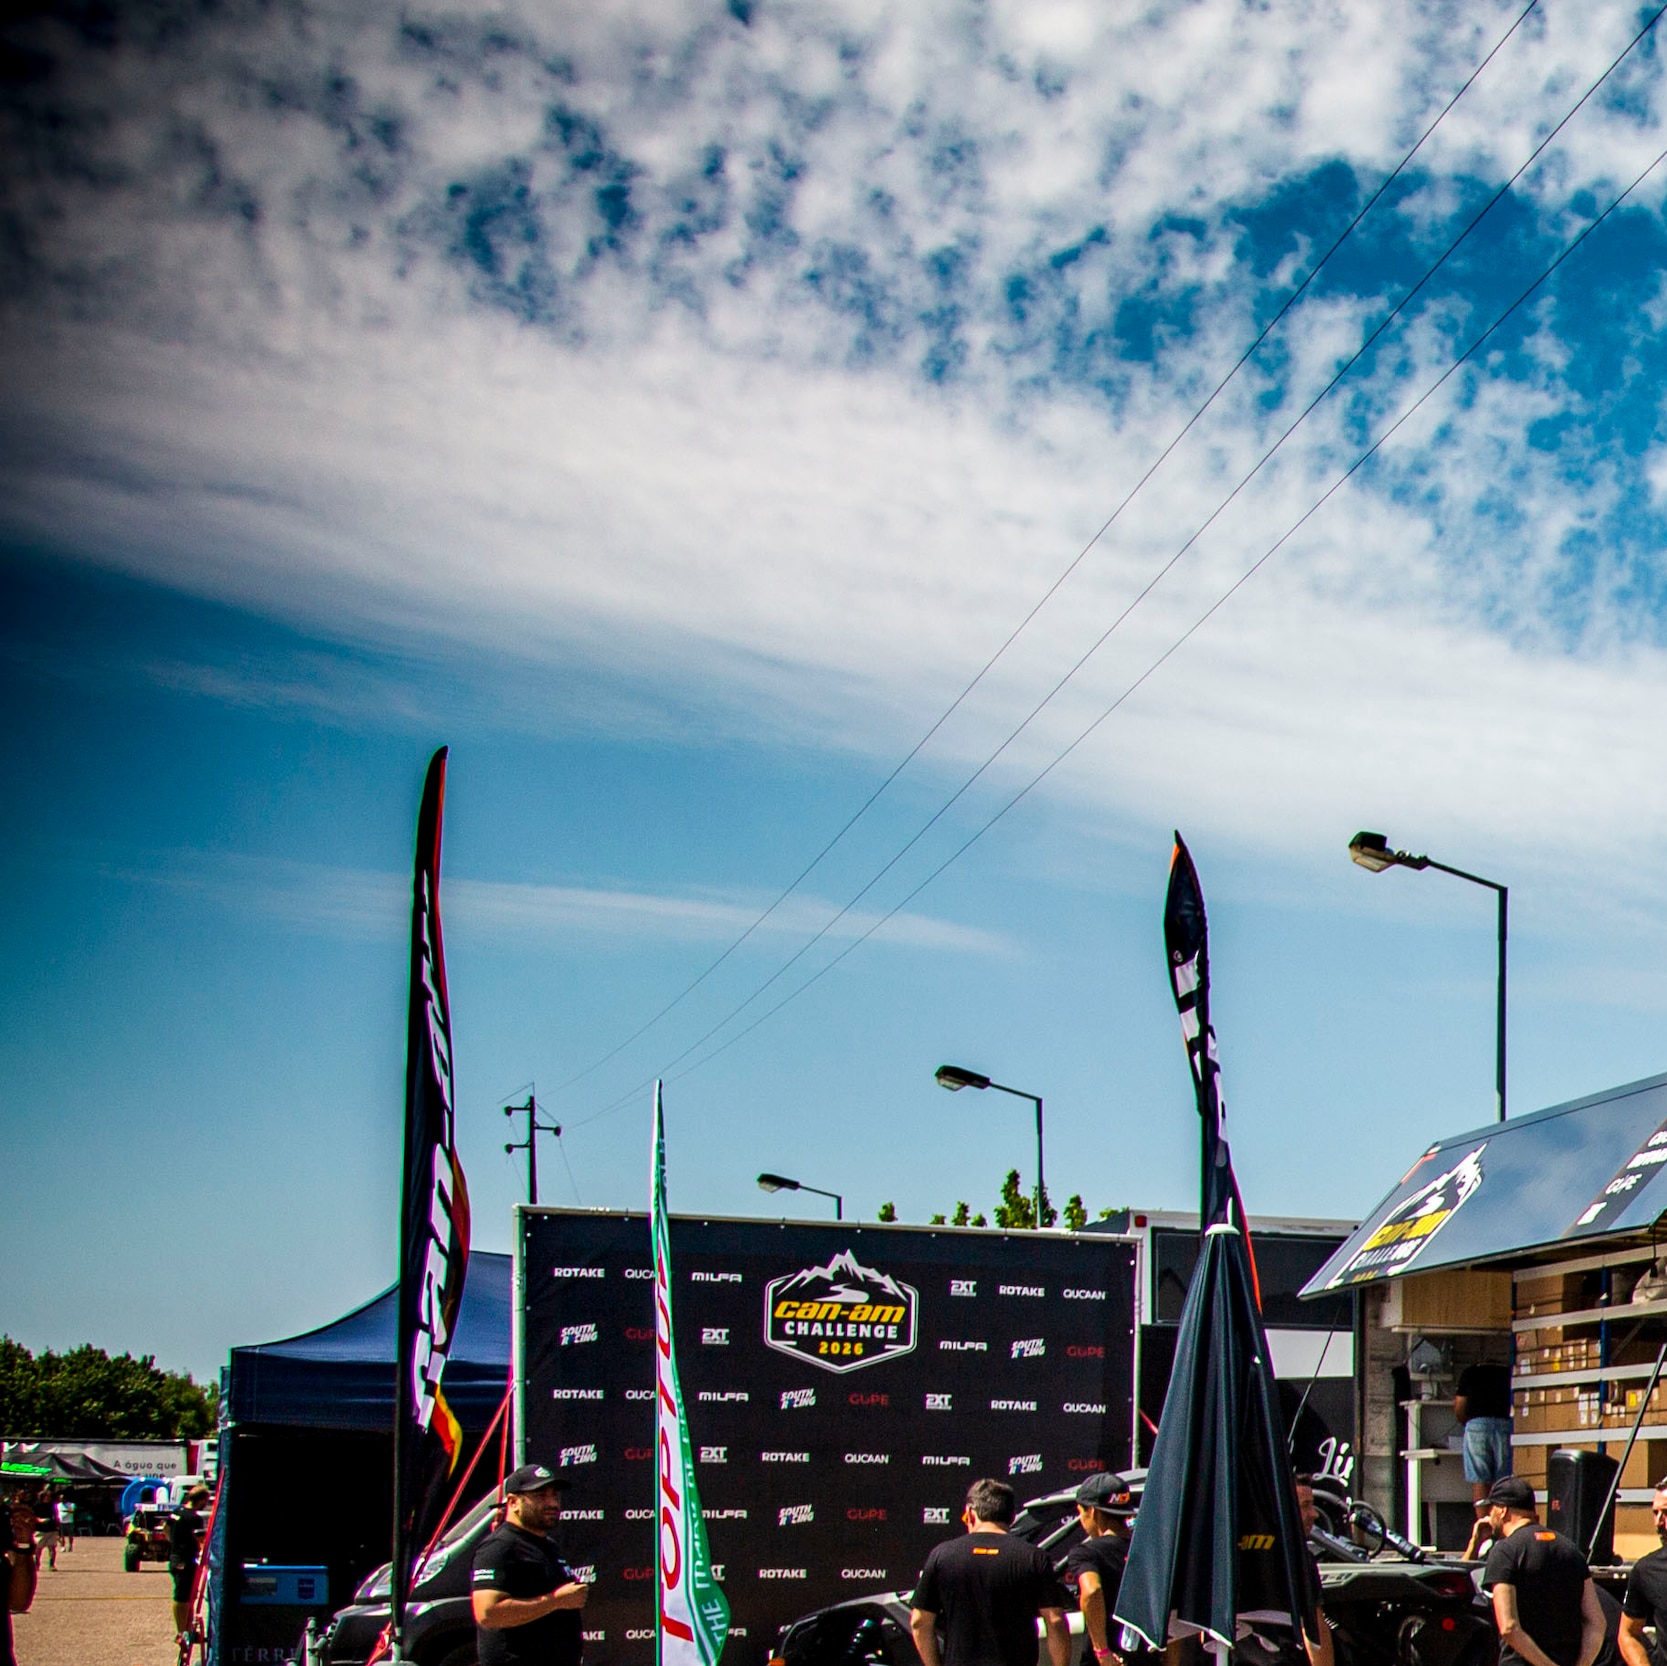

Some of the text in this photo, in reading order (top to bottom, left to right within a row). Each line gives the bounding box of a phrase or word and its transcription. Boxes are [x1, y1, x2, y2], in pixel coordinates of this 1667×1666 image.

[555, 1268, 604, 1277] ROTAKE
[999, 1285, 1044, 1297] ROTAKE
[1063, 1289, 1105, 1299] QUCAAN
[774, 1301, 906, 1323] can-am
[784, 1321, 898, 1339] CHALLENGE
[819, 1341, 864, 1355] 2026
[554, 1390, 603, 1399] ROTAKE
[991, 1400, 1036, 1411] ROTAKE
[1063, 1403, 1106, 1413] QUCAAN
[762, 1452, 809, 1462] ROTAKE
[845, 1454, 888, 1463] QUCAAN
[760, 1569, 806, 1578] ROTAKE
[842, 1569, 885, 1578] QUCAAN
